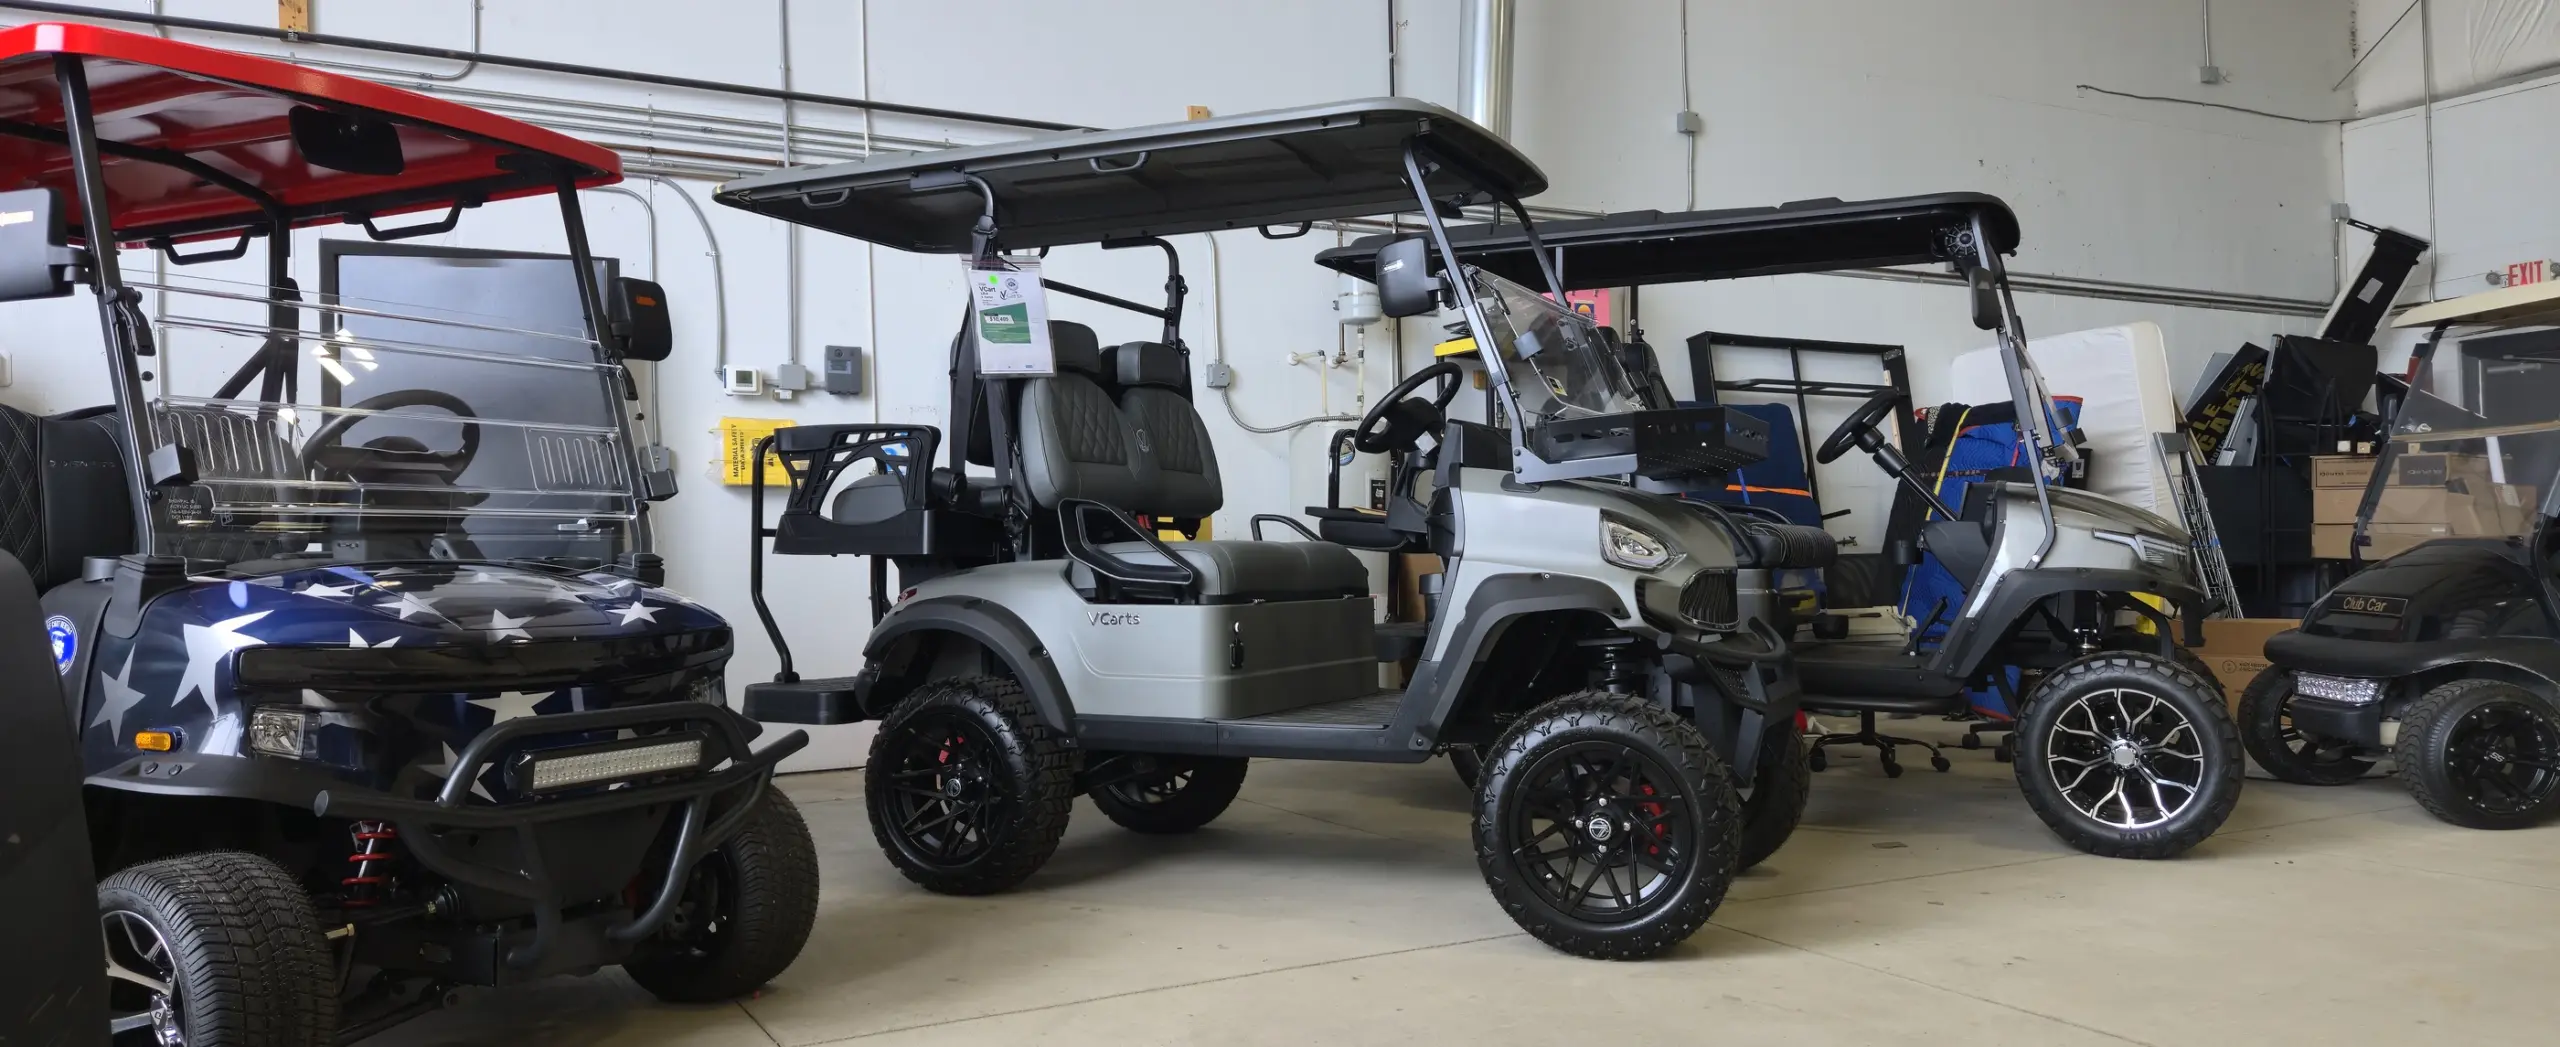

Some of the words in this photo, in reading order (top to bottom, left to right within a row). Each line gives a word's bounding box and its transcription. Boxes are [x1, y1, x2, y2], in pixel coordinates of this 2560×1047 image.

[2508, 260, 2543, 287] EXIT
[730, 424, 738, 446] SAFETY
[731, 447, 739, 478] MATERIAL
[2343, 597, 2364, 610] Club
[2367, 598, 2387, 612] Car
[1087, 611, 1141, 626] VCarts
